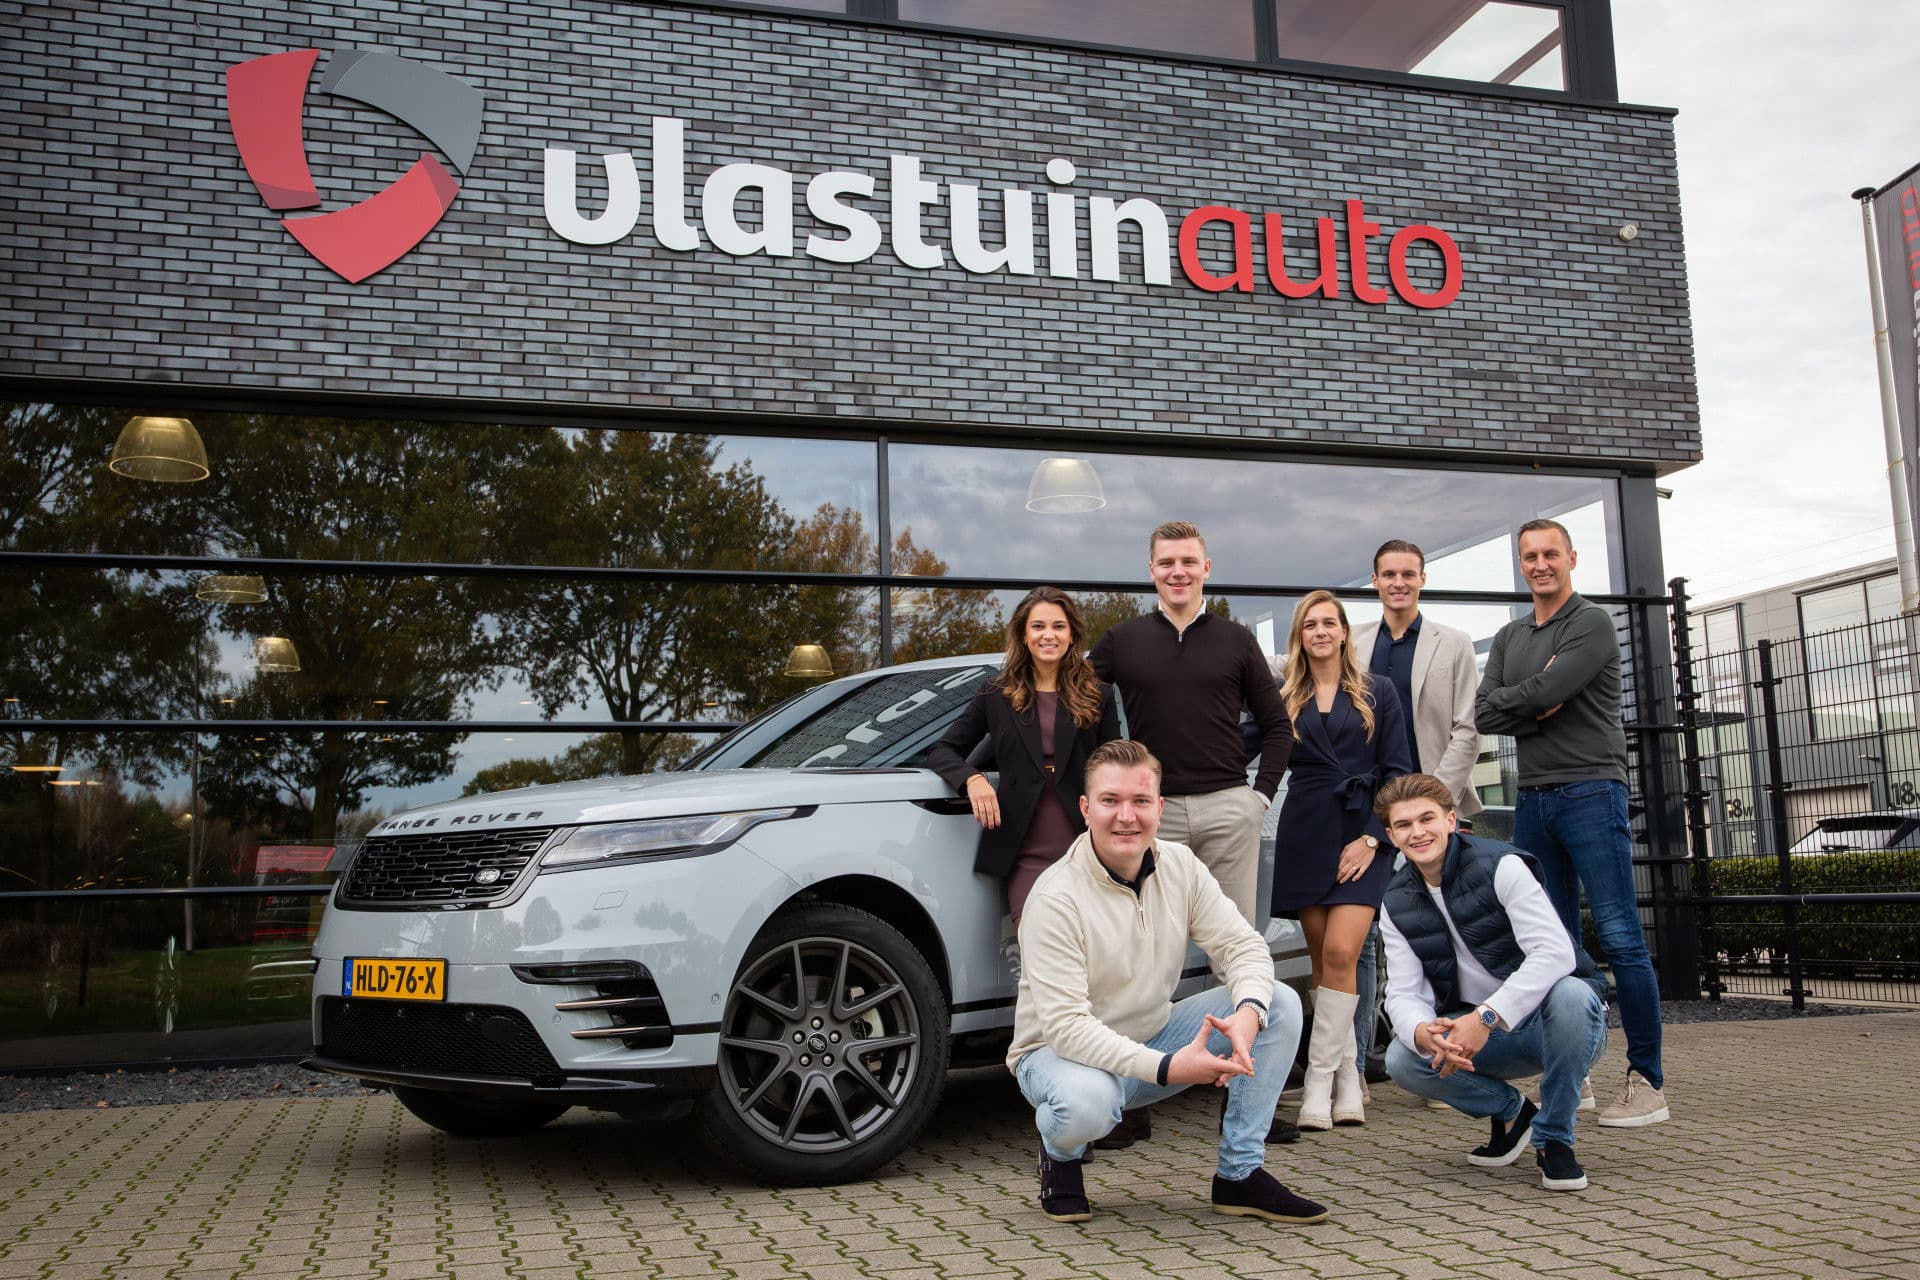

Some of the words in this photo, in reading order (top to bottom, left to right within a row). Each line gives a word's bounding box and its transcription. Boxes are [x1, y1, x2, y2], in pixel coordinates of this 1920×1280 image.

[1891, 781, 1920, 805] 18
[378, 817, 440, 831] RANGE
[450, 810, 543, 826] ROVER
[356, 964, 437, 994] HLD-76-X
